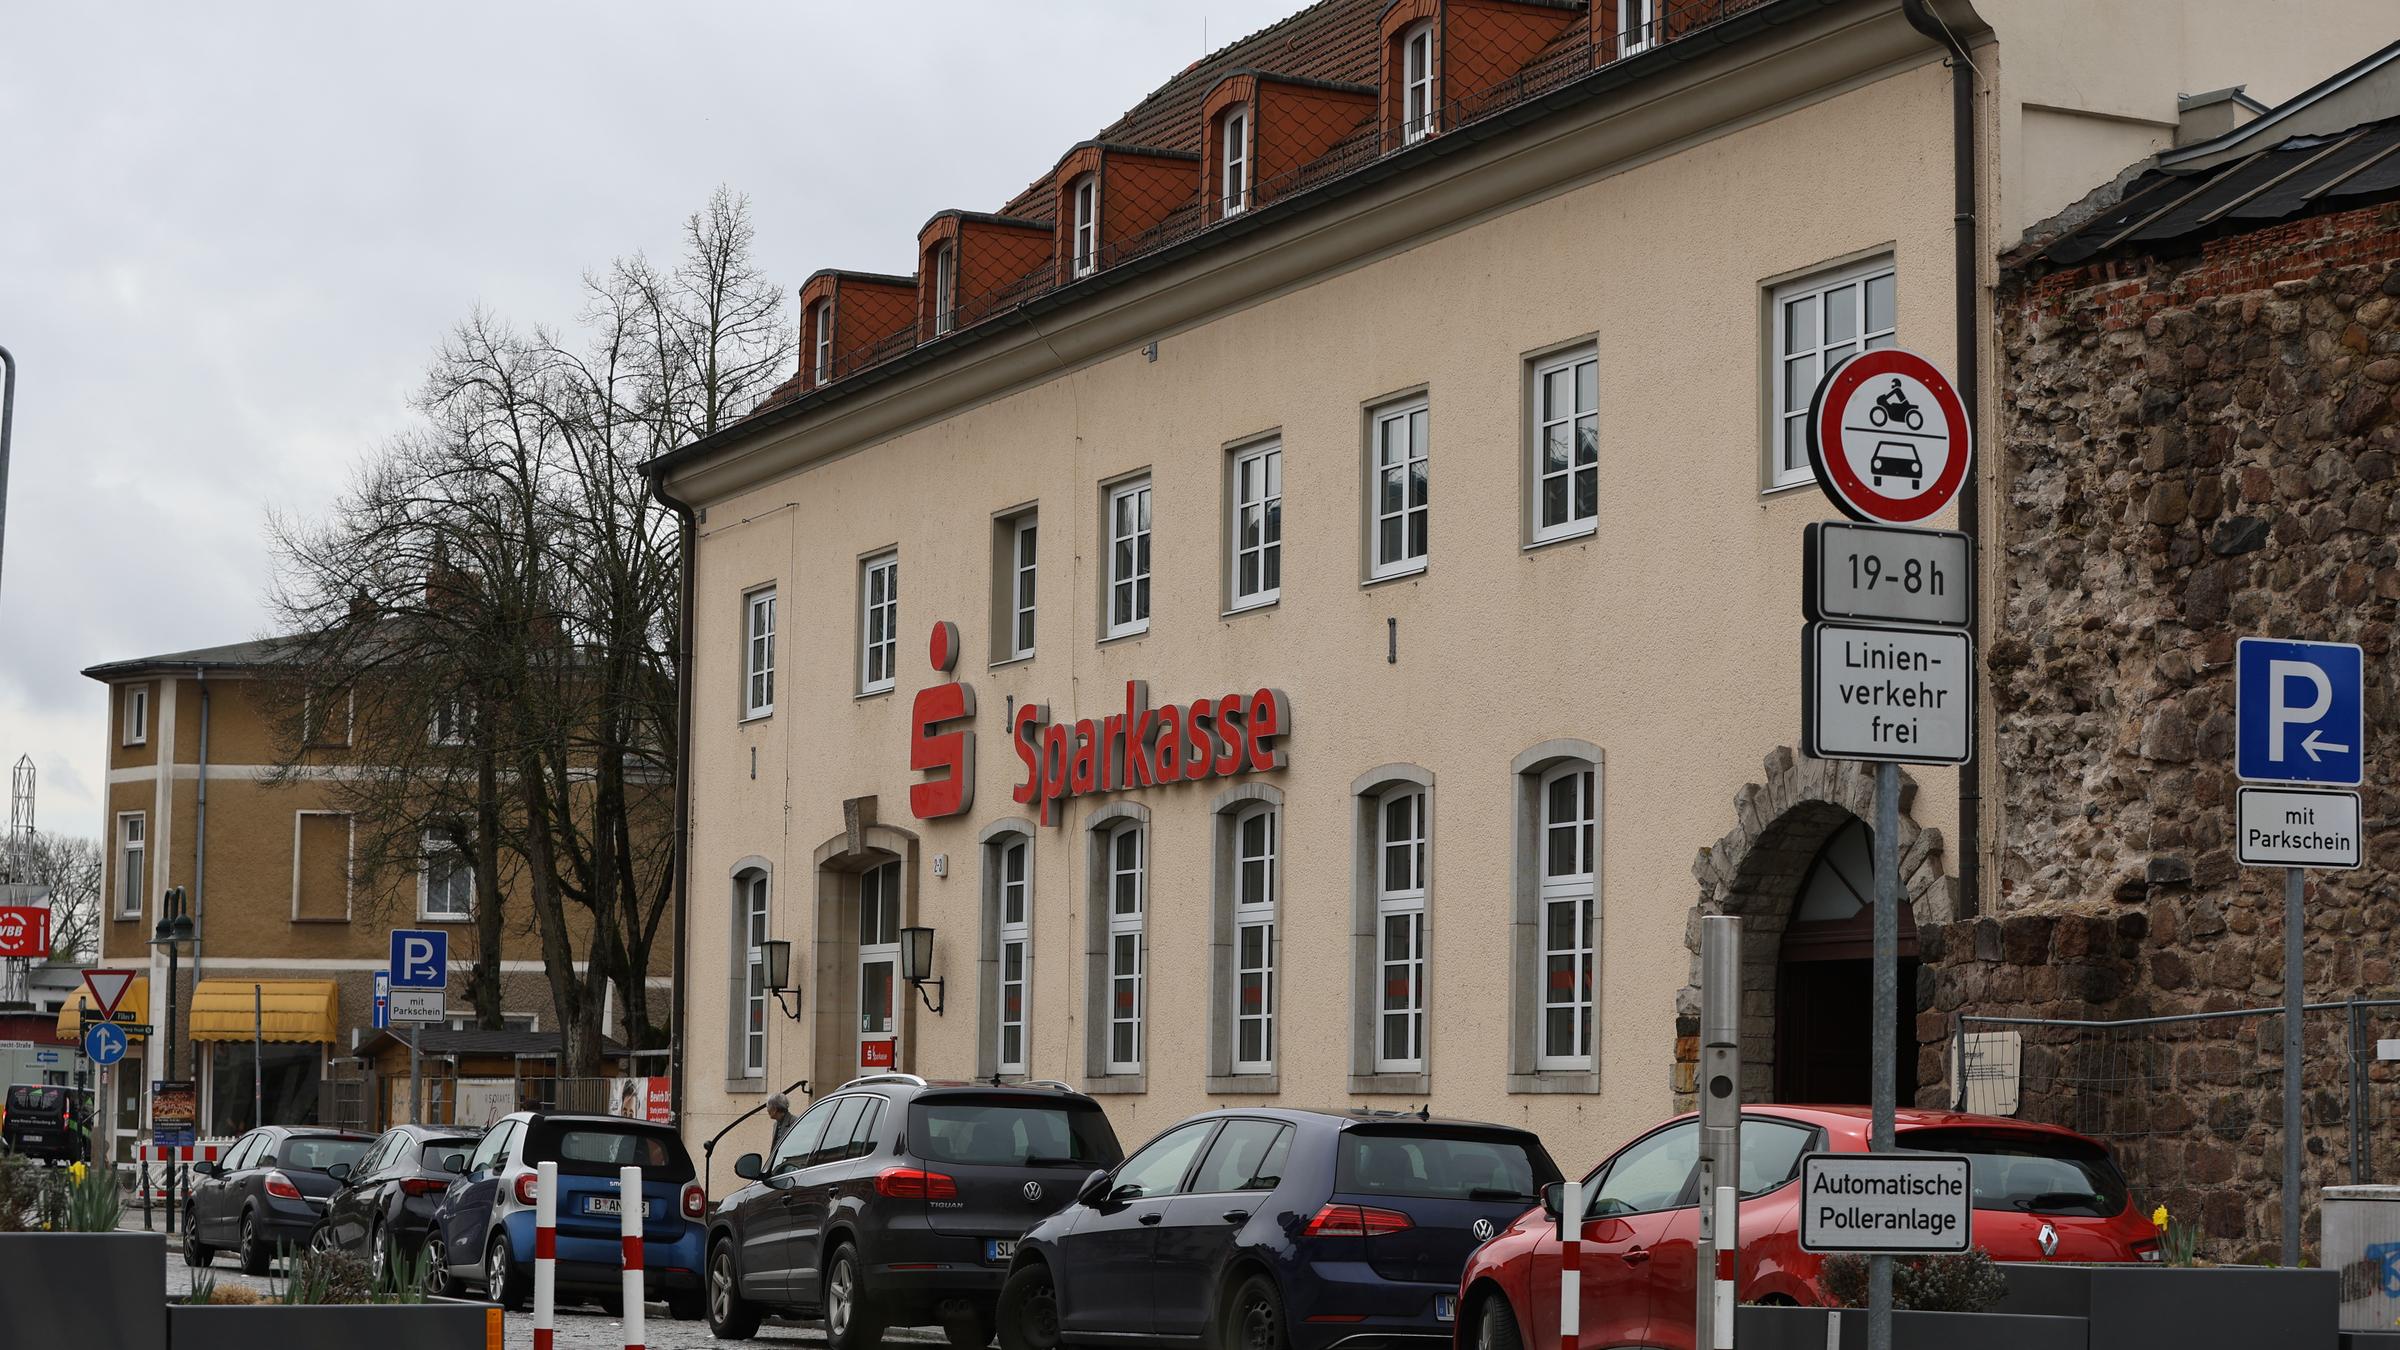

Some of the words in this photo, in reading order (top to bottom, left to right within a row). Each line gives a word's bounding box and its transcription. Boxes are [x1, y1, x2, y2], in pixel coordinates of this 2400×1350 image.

[1845, 640, 1942, 671] Linien-
[1839, 680, 1948, 709] verkehr
[2268, 659, 2333, 762] P
[1871, 716, 1918, 744] frei
[1012, 679, 1291, 828] Sparkasse
[2285, 808, 2315, 825] mit
[2249, 829, 2350, 850] Parkschein
[403, 937, 434, 980] P
[393, 1006, 440, 1016] Parkschein
[410, 997, 424, 1006] mit
[1813, 1172, 1962, 1195] Automatische
[594, 1199, 602, 1210] B
[1820, 1206, 1956, 1235] Polleranlage
